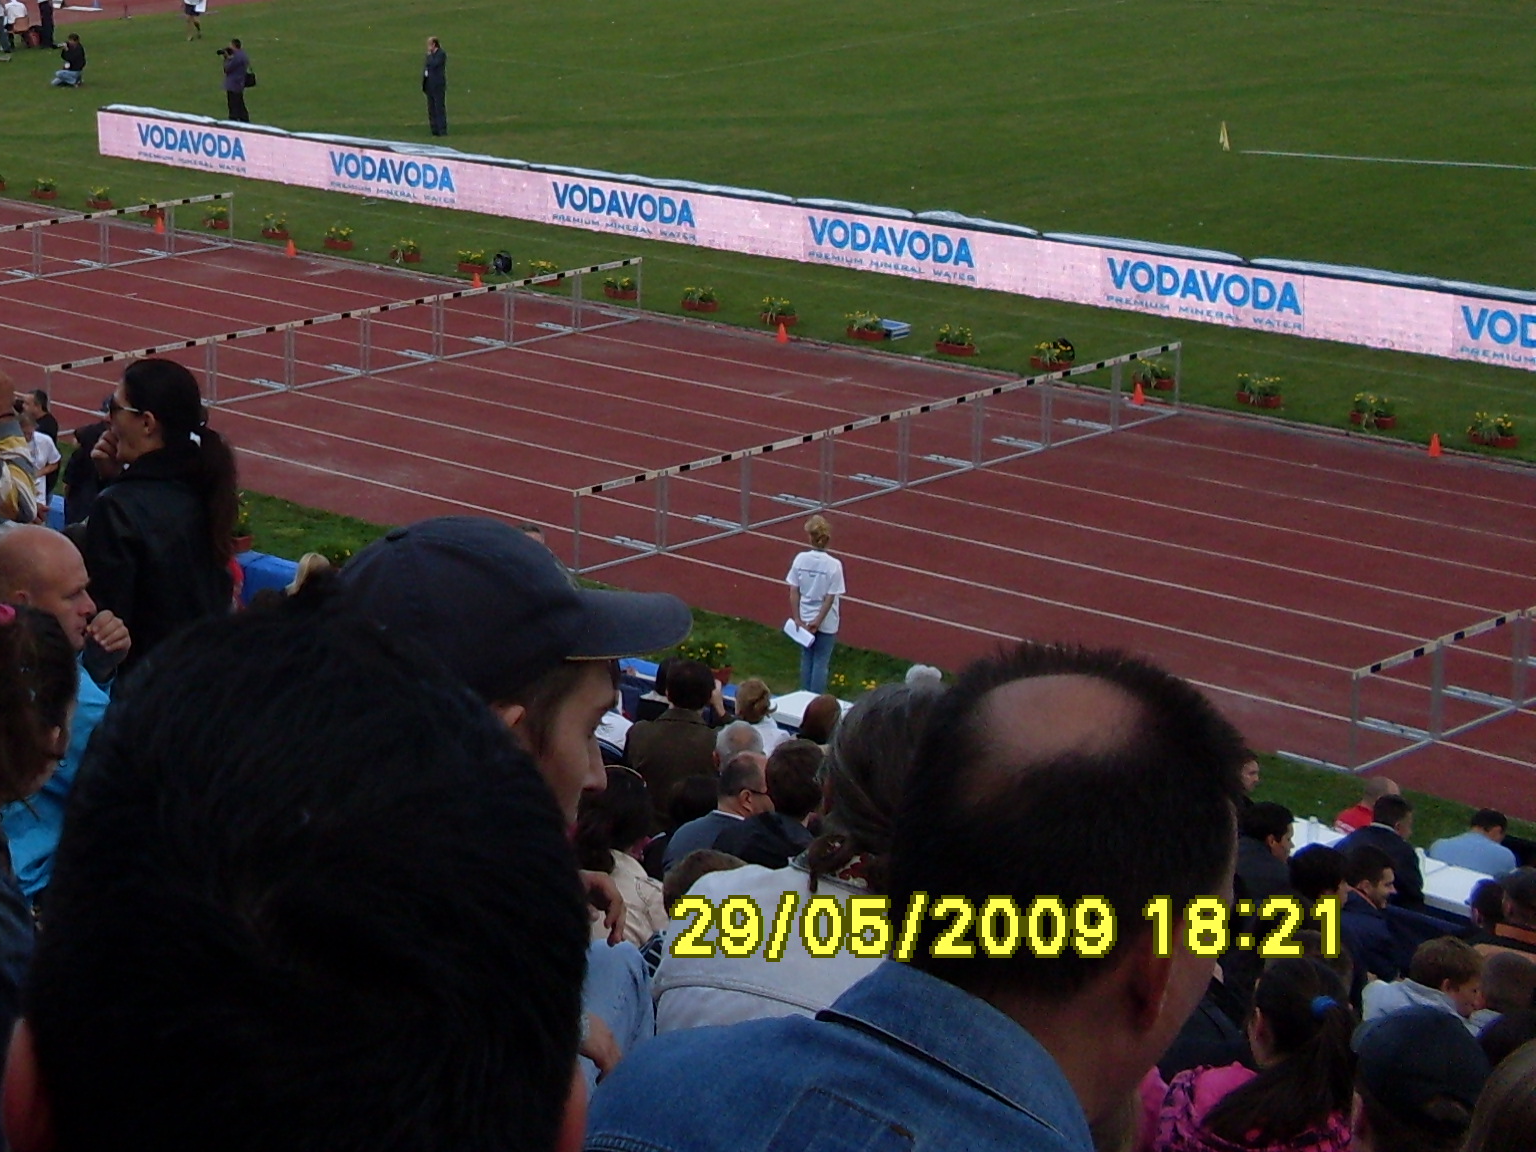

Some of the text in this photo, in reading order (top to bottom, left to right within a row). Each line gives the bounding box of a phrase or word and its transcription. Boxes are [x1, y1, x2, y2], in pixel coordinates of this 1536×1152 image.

[136, 123, 246, 162] VODAVODA
[329, 151, 456, 193] VODAVODA
[552, 181, 696, 229] VODAVODA
[552, 213, 601, 229] PREMIUM
[605, 221, 653, 237] MINERAL
[807, 215, 975, 269] VODAVODA
[807, 250, 976, 282] PREMIUM MINERAL WATER
[1107, 257, 1302, 316] VODAVODA
[1106, 295, 1304, 332] PREMIUM MINERAL WATER
